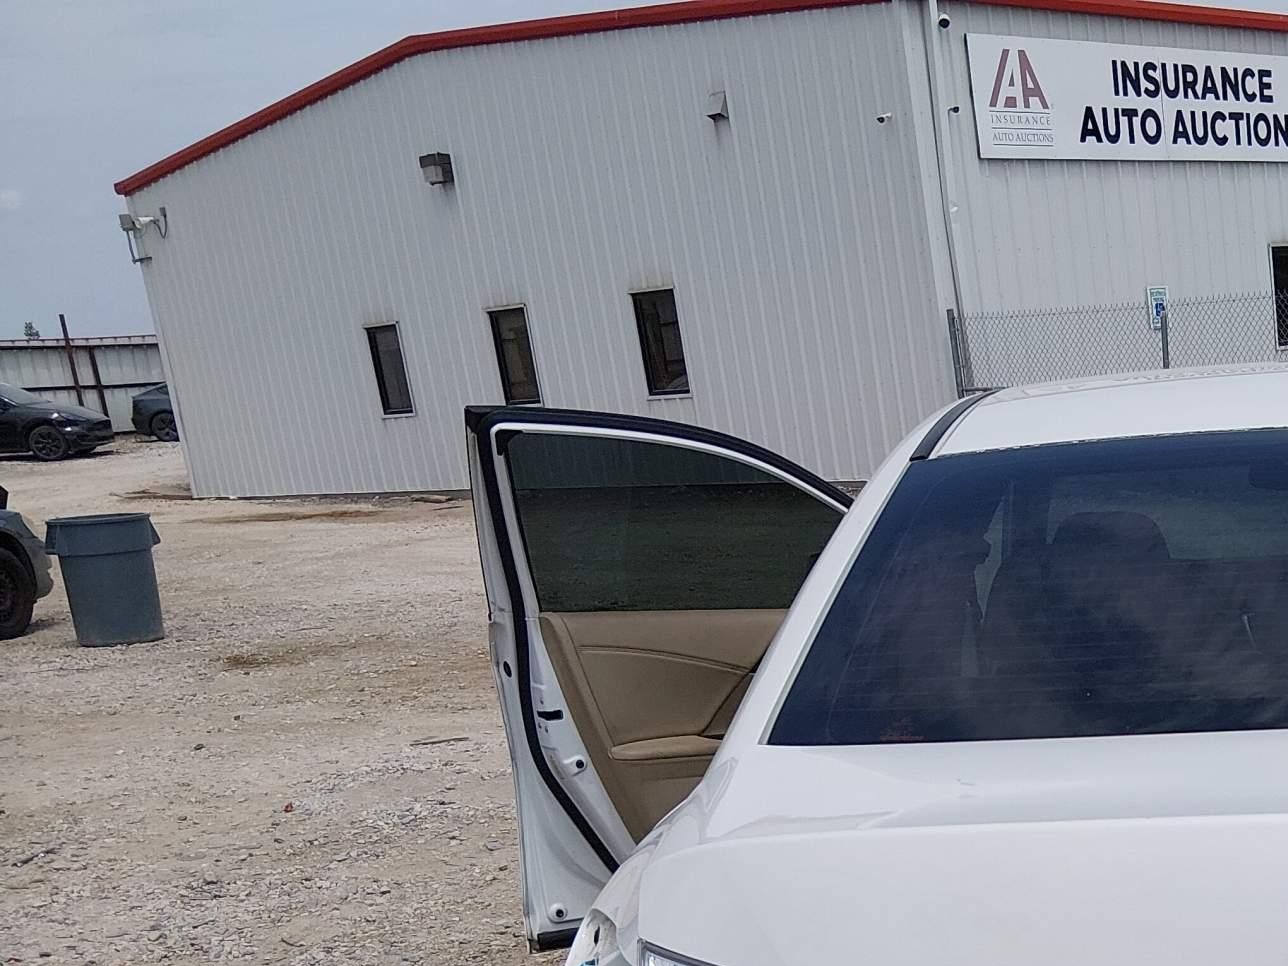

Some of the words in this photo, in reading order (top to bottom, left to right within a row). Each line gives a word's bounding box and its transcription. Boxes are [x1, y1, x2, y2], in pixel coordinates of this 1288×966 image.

[1111, 59, 1274, 104] INSURANCE
[991, 114, 1051, 126] INSURANCE
[1079, 105, 1163, 145] AUTO
[992, 131, 1015, 142] AUTO
[1015, 132, 1054, 143] AUCTIONS
